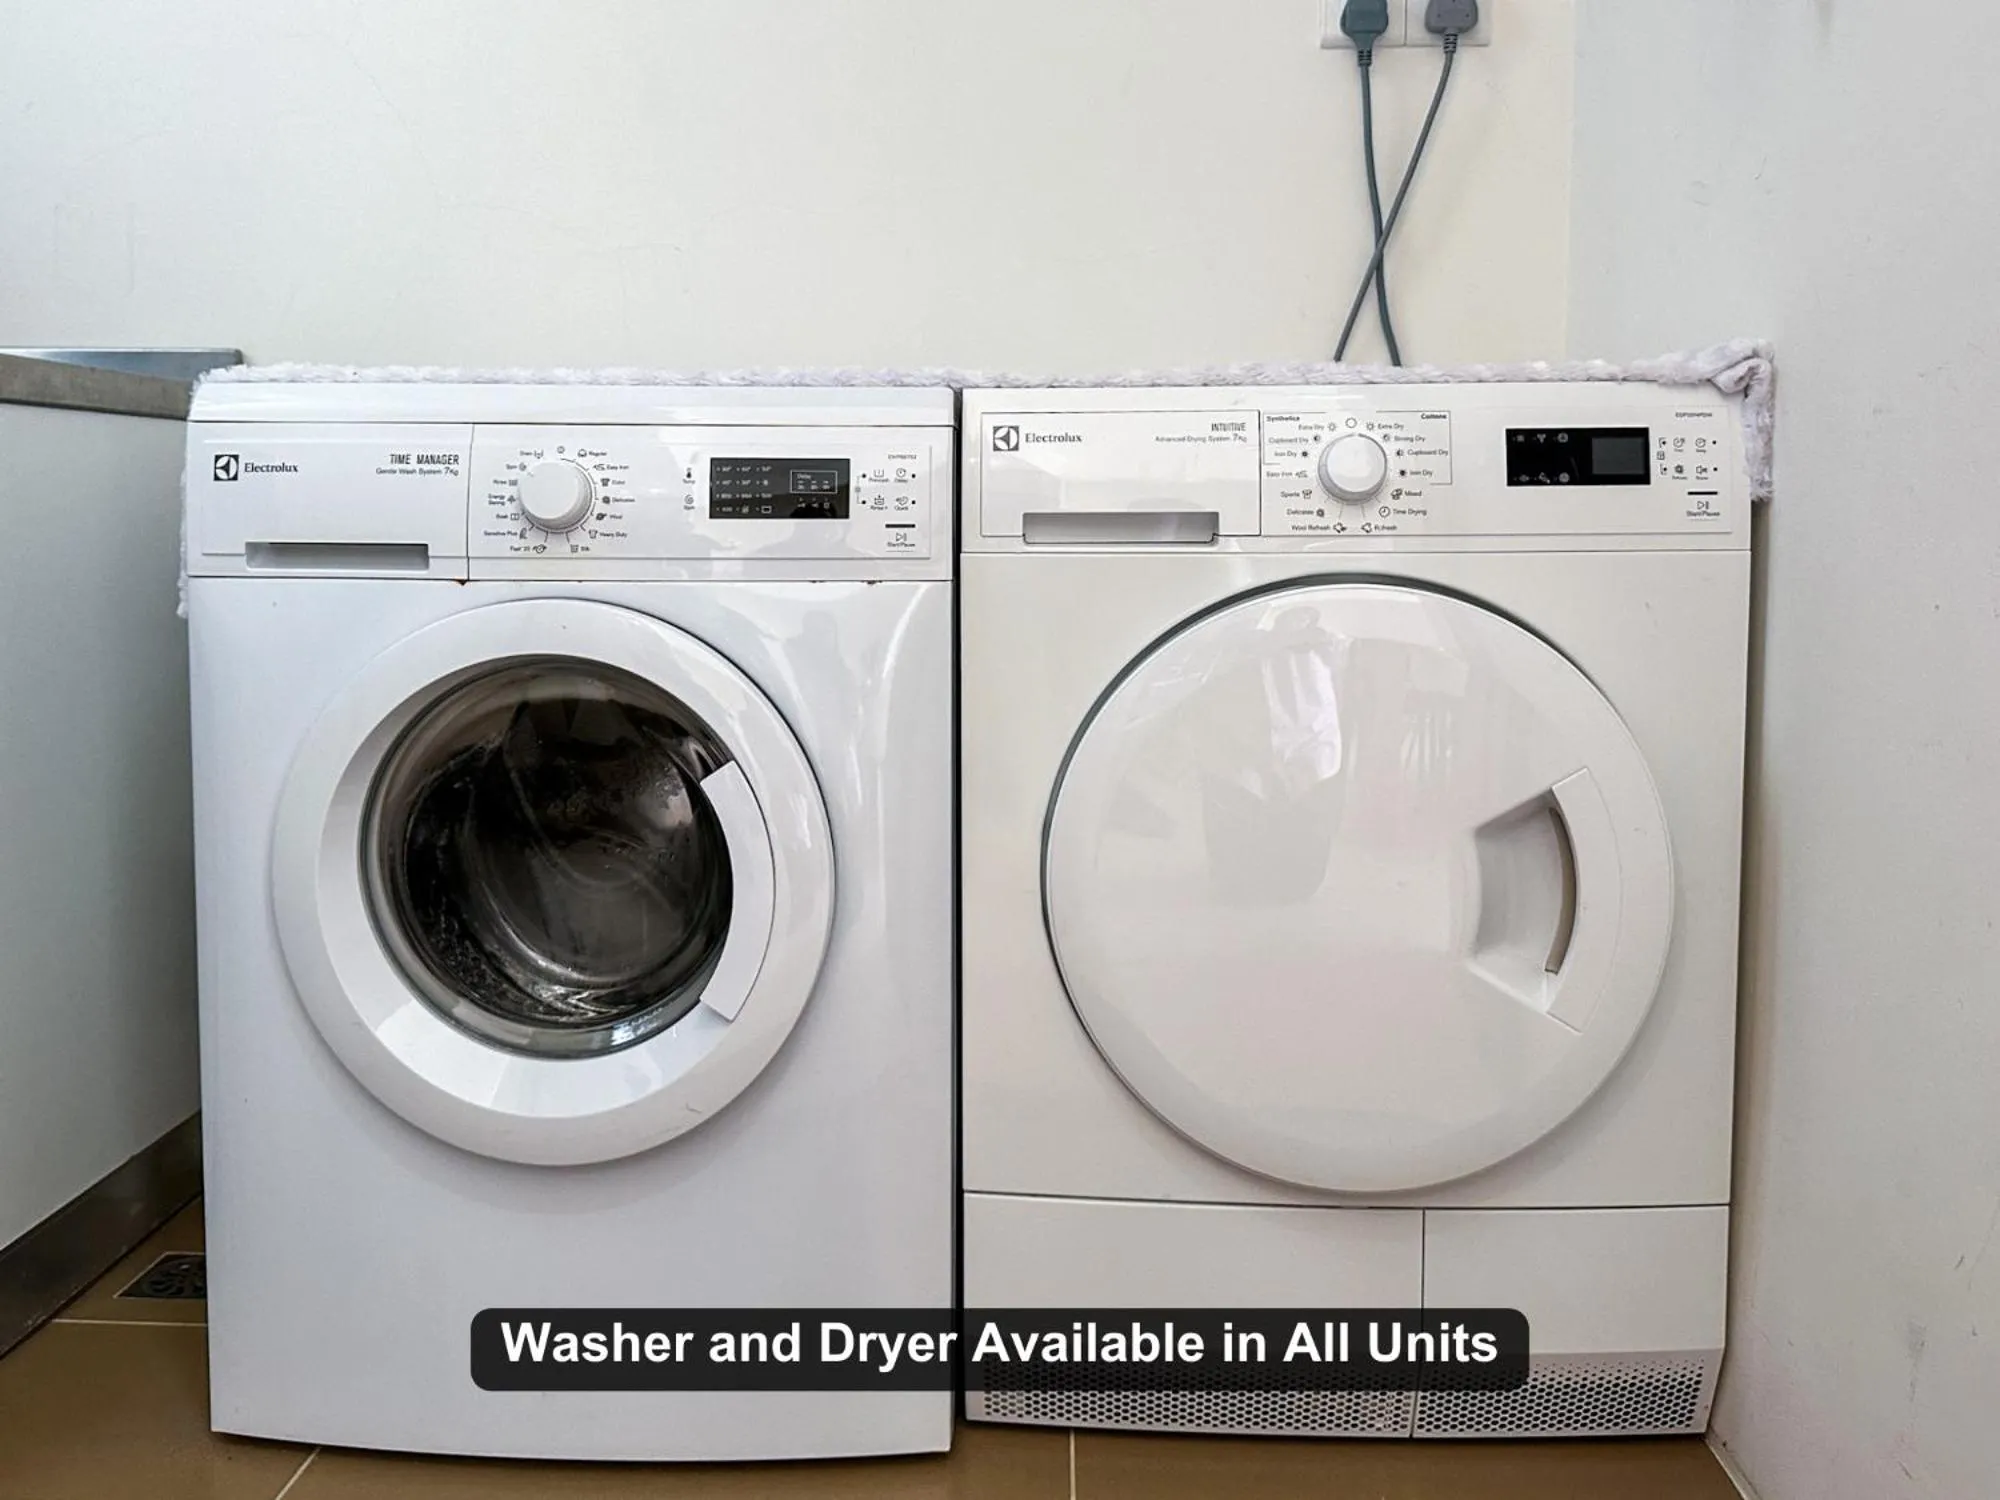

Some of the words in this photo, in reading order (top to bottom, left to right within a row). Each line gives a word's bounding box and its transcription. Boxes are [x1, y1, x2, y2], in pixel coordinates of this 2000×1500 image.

[1394, 423, 1404, 431] Dry
[1024, 432, 1083, 443] Electrolux
[389, 453, 411, 464] TIME
[417, 453, 459, 465] MANAGER
[244, 462, 298, 473] Electrolux
